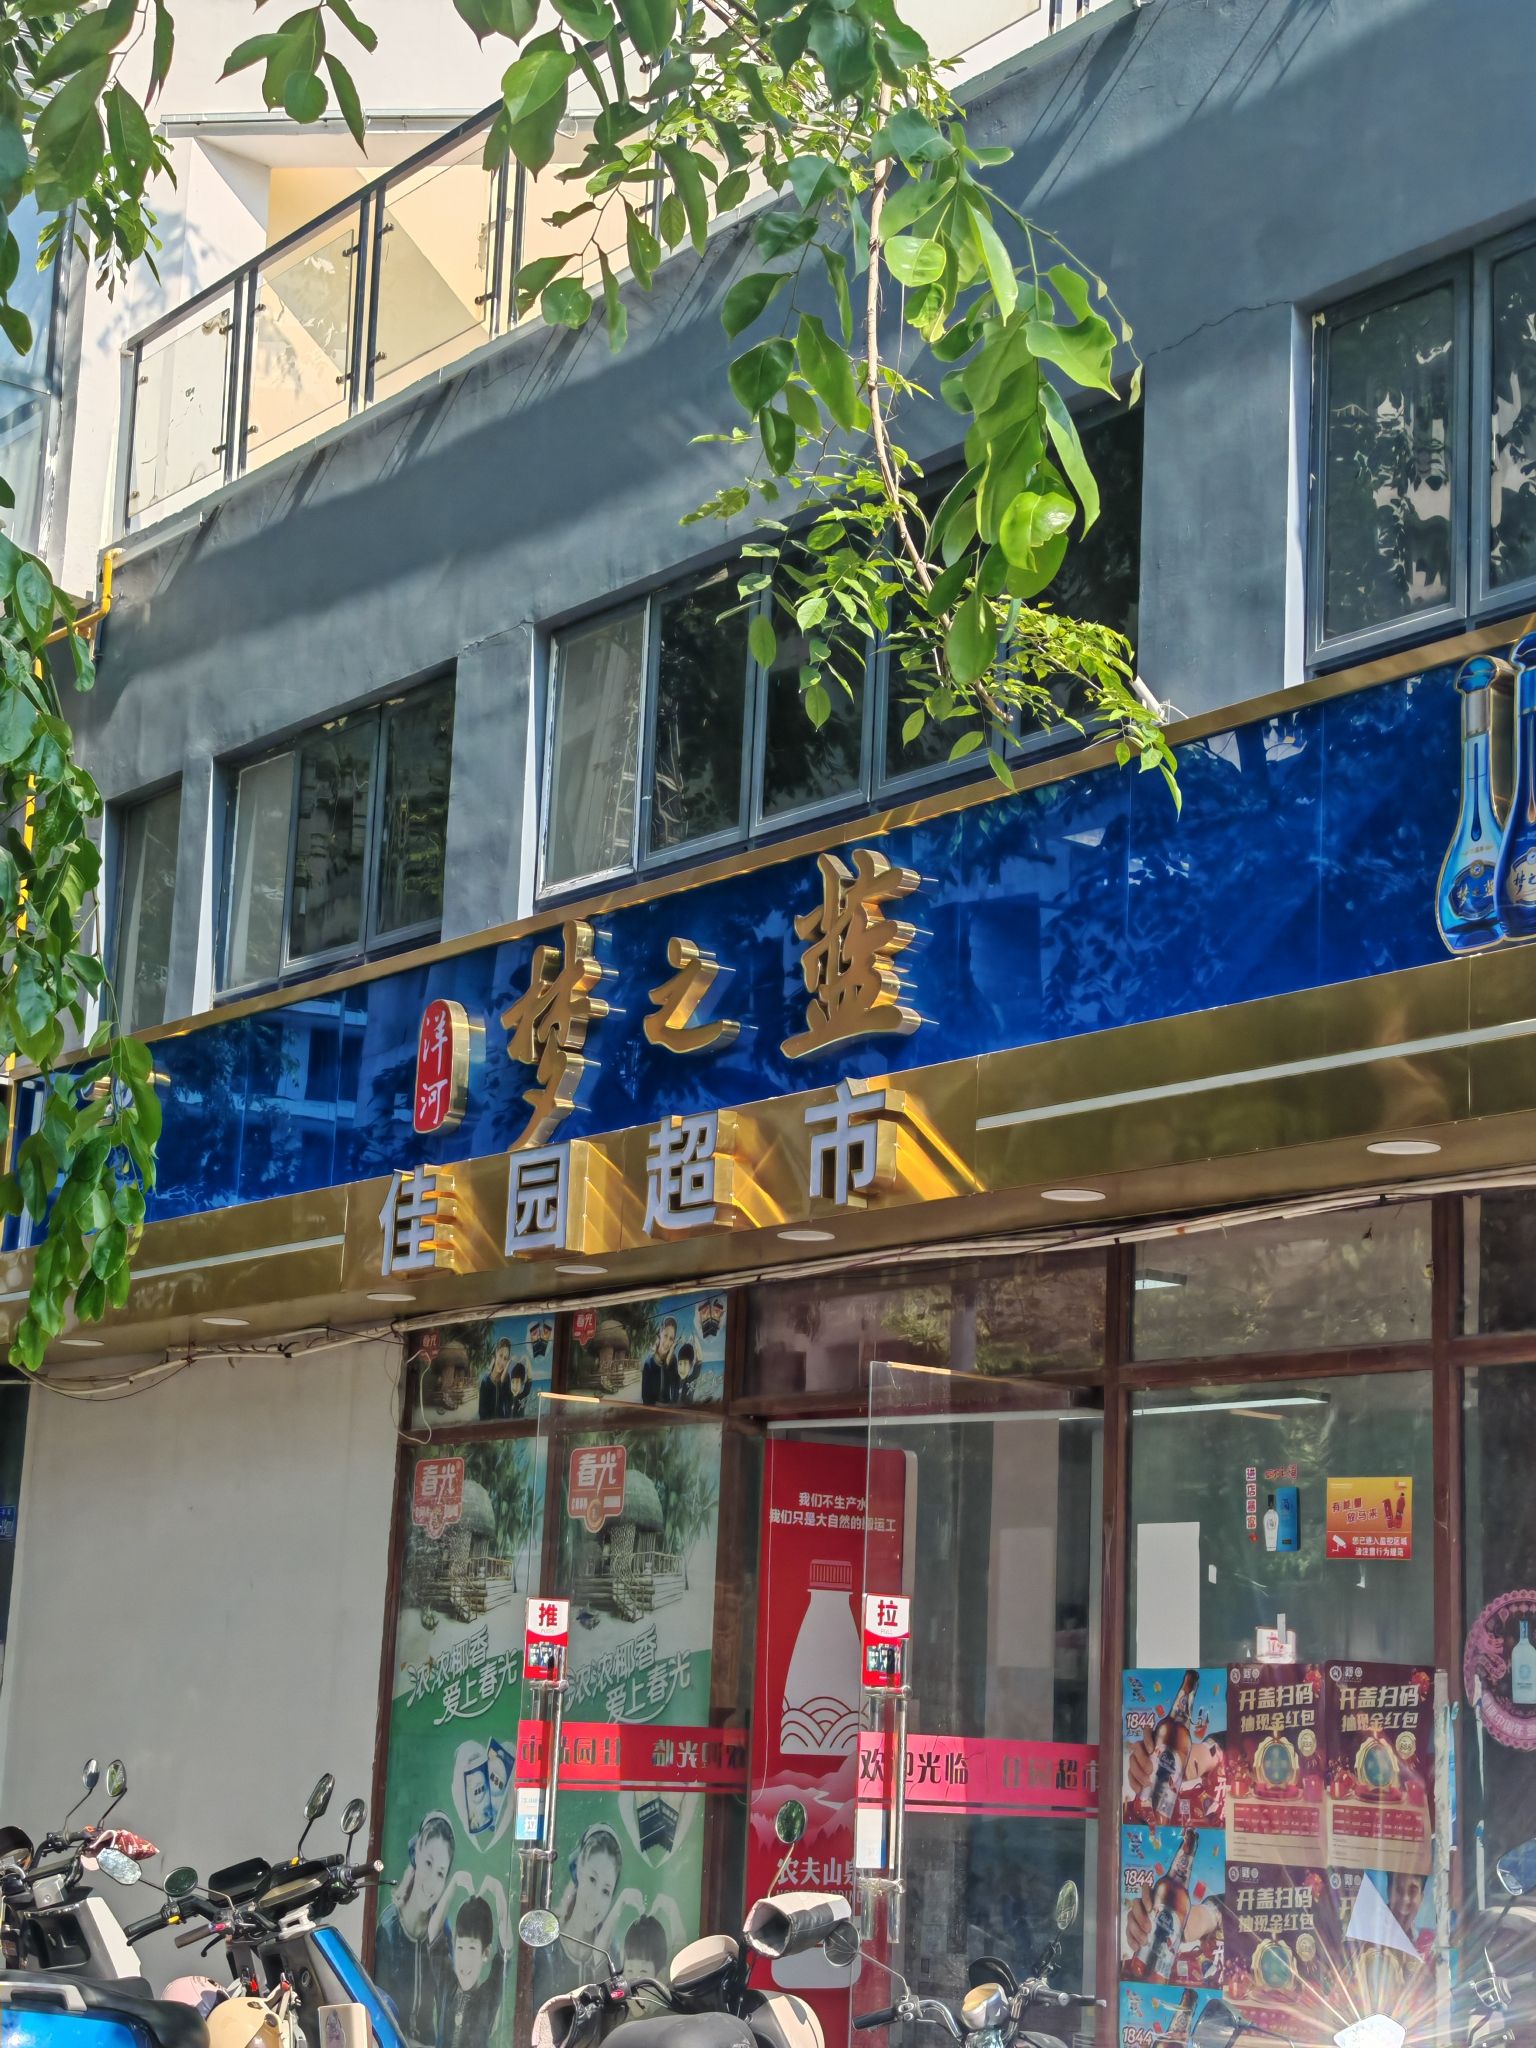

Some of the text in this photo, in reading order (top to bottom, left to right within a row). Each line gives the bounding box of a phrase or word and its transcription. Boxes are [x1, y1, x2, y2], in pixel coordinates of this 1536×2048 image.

[502, 849, 916, 1148] 梦之蓝
[418, 1014, 448, 1125] 洋河
[379, 1080, 890, 1277] 佳园超市
[421, 1463, 456, 1504] 春光
[577, 1451, 617, 1496] 春光
[799, 1492, 867, 1511] 我们不生产水
[538, 1603, 558, 1627] 推
[877, 1600, 898, 1626] 拉
[407, 1624, 489, 1707] 浓浓椰香
[433, 1649, 518, 1725] 爱上春光
[606, 1650, 690, 1724] 爱上春光
[1239, 1683, 1313, 1711] 开盖扫码
[1339, 1684, 1420, 1710] 开盖扫码
[1126, 1712, 1155, 1729] 1844
[1241, 1709, 1315, 1733] 抽现金红包
[1341, 1711, 1419, 1732] 抽现金红包
[1124, 1869, 1154, 1887] 1844
[1237, 1886, 1313, 1911] 开盖扫码
[1239, 1913, 1315, 1933] 抽现金红包
[1123, 2026, 1153, 2046] 1844
